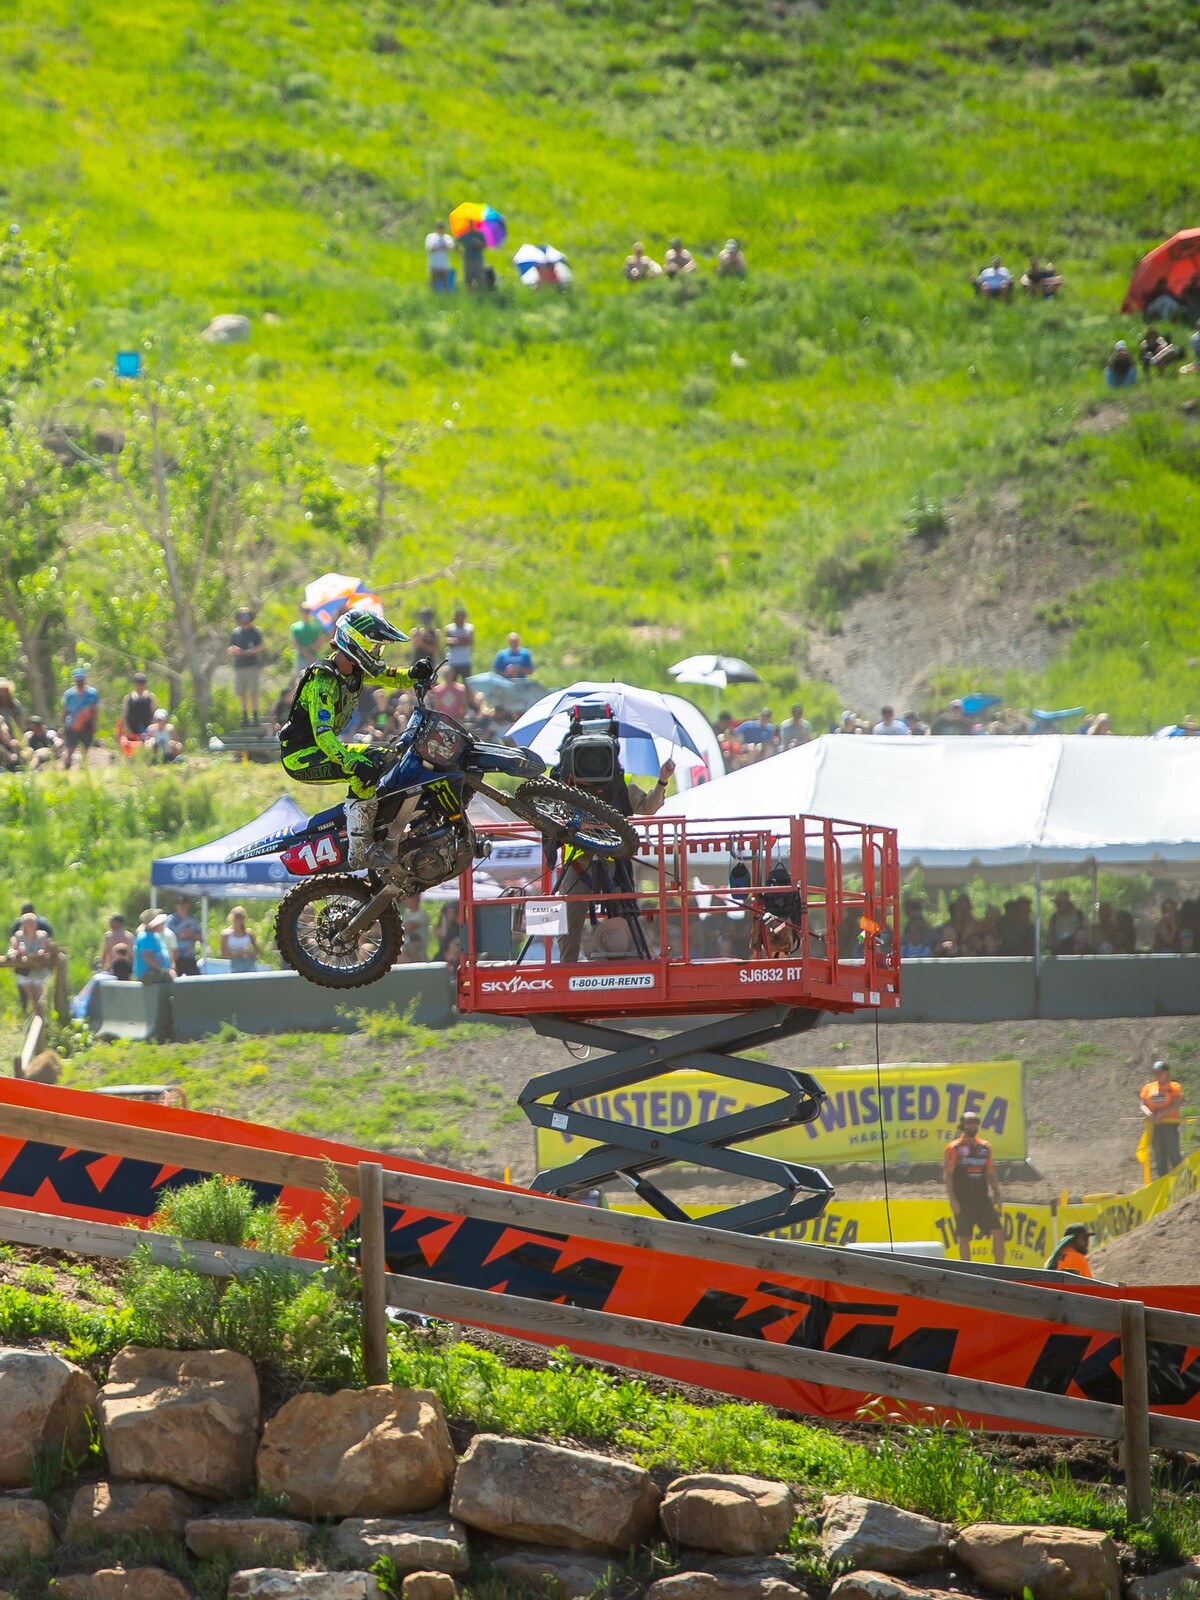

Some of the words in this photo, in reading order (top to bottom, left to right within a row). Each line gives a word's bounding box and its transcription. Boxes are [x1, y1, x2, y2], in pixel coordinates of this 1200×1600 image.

[316, 821, 335, 832] YAMAHA
[243, 844, 279, 859] DUNLOP
[298, 837, 338, 870] 14
[190, 863, 248, 879] YAMAHA
[739, 968, 783, 982] SJ6832
[787, 967, 802, 980] RT
[481, 976, 554, 993] SKYJACK
[572, 976, 651, 988] 1-800-UR-RENTS
[563, 1090, 692, 1144] WISTED
[698, 1088, 758, 1122] TE
[946, 1082, 1008, 1135] TEA
[850, 1130, 888, 1144] HARD
[896, 1127, 928, 1140] ICED
[1016, 1211, 1047, 1257] TEA
[681, 1280, 960, 1375] KTM
